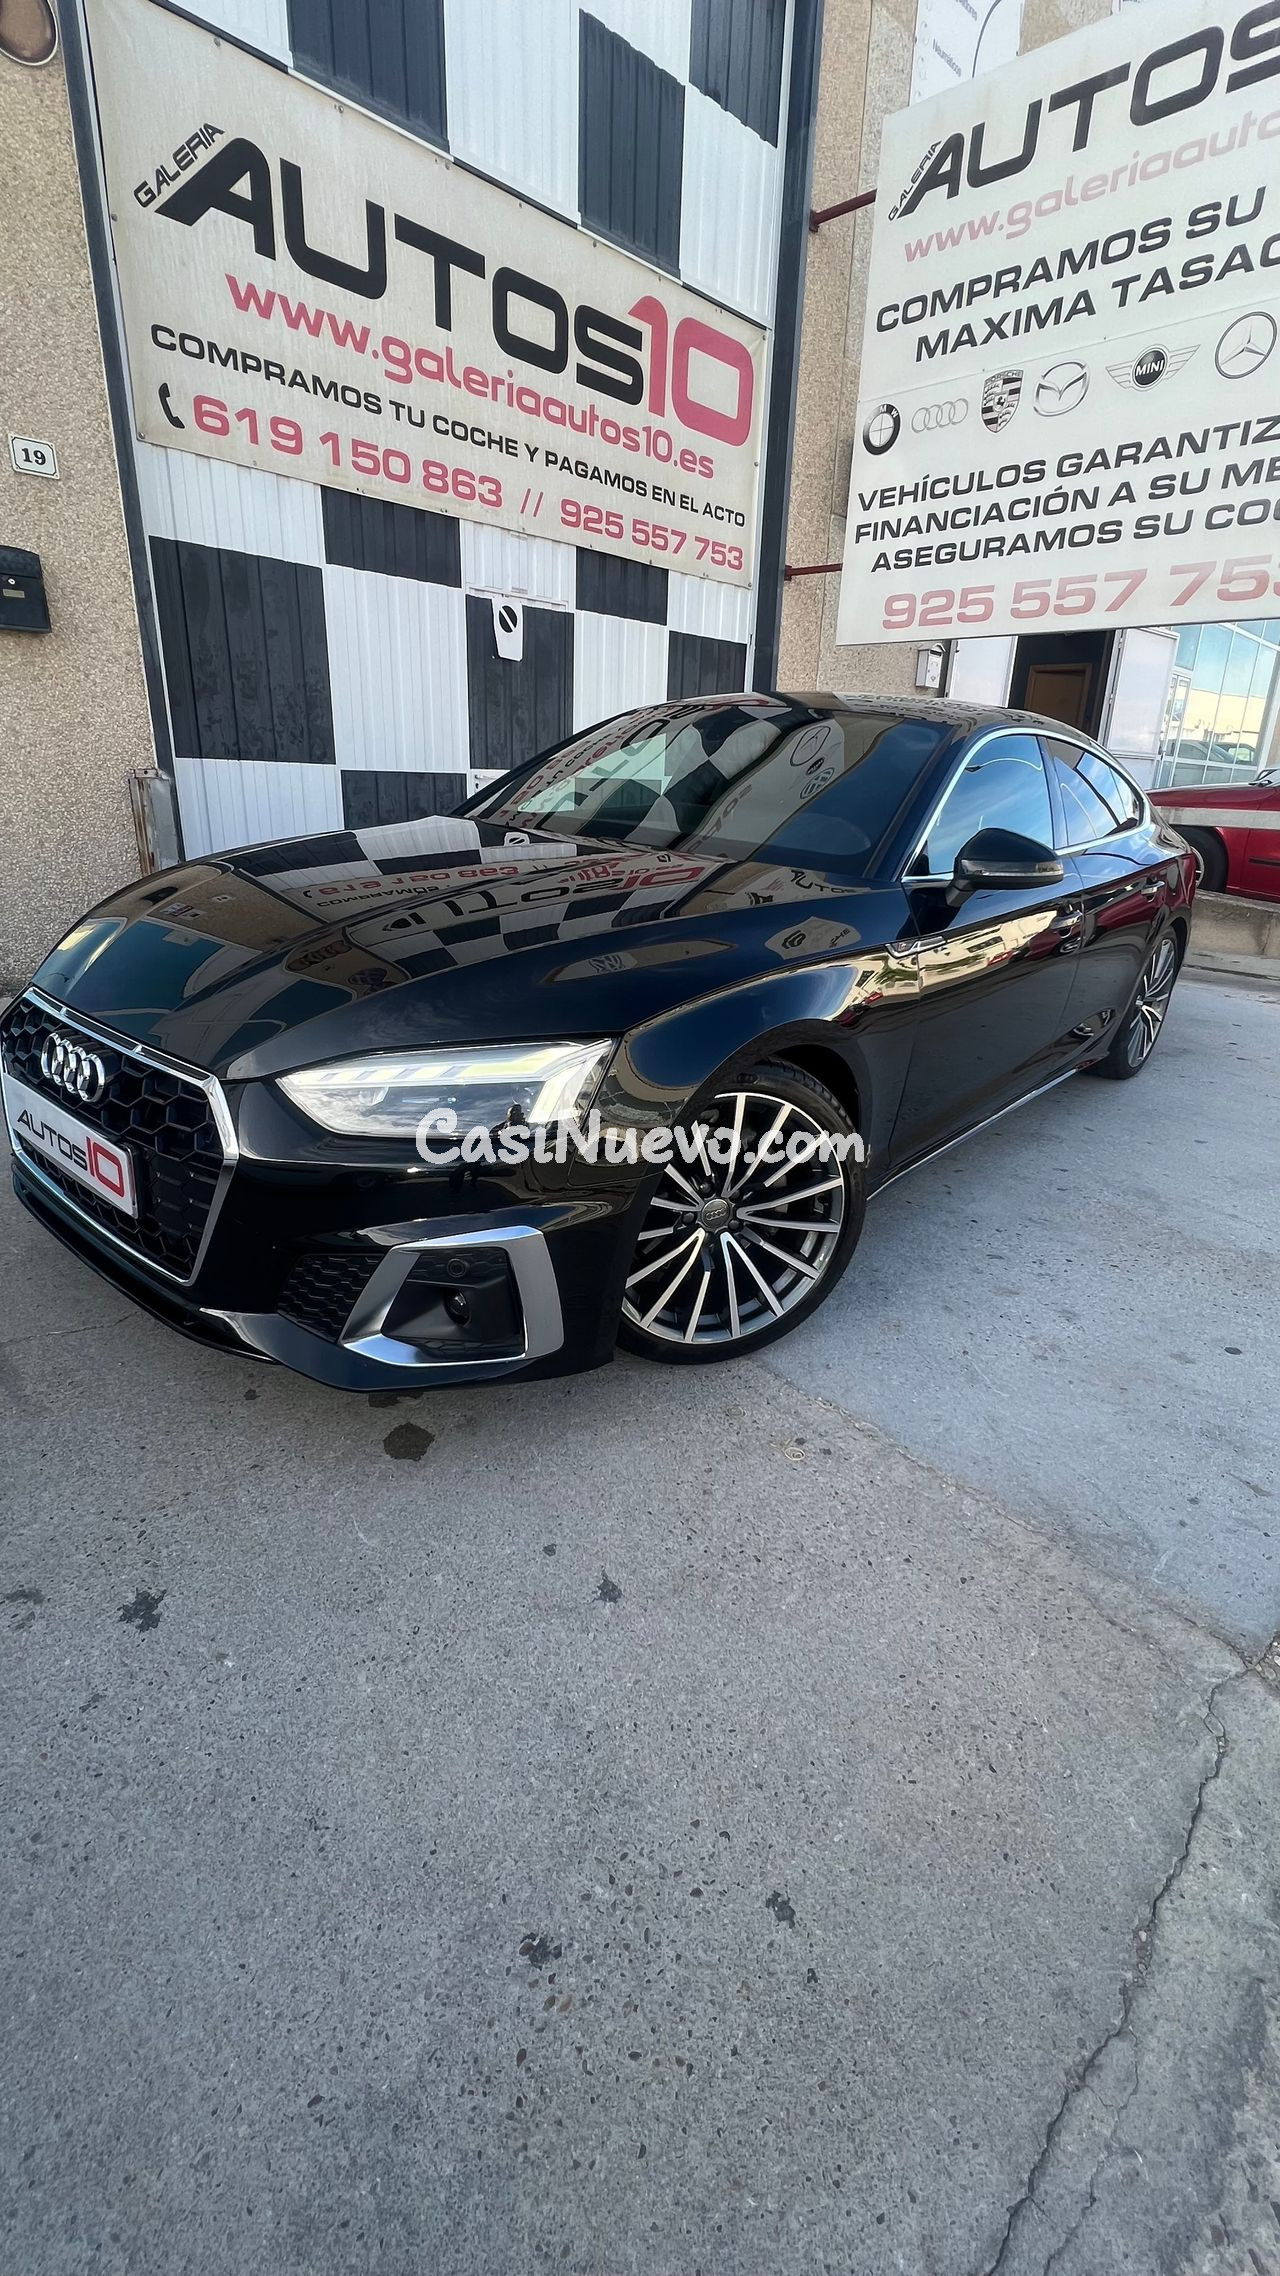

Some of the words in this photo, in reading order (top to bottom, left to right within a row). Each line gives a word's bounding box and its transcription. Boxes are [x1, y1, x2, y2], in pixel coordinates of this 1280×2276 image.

[134, 122, 225, 208] GALERIA
[888, 140, 942, 222] GALERIA
[876, 217, 1172, 333] COMPRAMOS
[1185, 186, 1267, 240] SU
[915, 290, 1097, 363] MAXIMA
[1135, 360, 1165, 376] MINI
[225, 273, 714, 479] www.galeriaautos10.es
[21, 448, 46, 466] 19
[150, 323, 383, 415] COMPRAMOS
[389, 399, 426, 428] TU
[432, 415, 519, 457] COCHE
[524, 443, 540, 463] Y
[545, 450, 648, 497] PAGAMOS
[651, 485, 676, 507] EN
[679, 495, 699, 513] EL
[702, 505, 746, 528] ACTO
[858, 459, 1047, 512] VEHÍCULOS
[1056, 415, 1280, 479] GARANTIZ
[192, 394, 304, 457] 619
[318, 431, 412, 485] 150
[422, 459, 503, 510] 863
[560, 498, 625, 540] 925
[632, 518, 687, 555] 557
[694, 535, 744, 571] 753
[854, 486, 1098, 545] FINANCIACIÓN
[1107, 481, 1137, 506] A
[1148, 468, 1211, 500] SU
[870, 520, 1122, 573] ASEGURAMOS
[1133, 509, 1194, 539] SU
[1205, 496, 1280, 530] CO
[881, 585, 996, 630] 925
[1010, 569, 1147, 620] 557
[17, 1108, 124, 1198] AUTOS10
